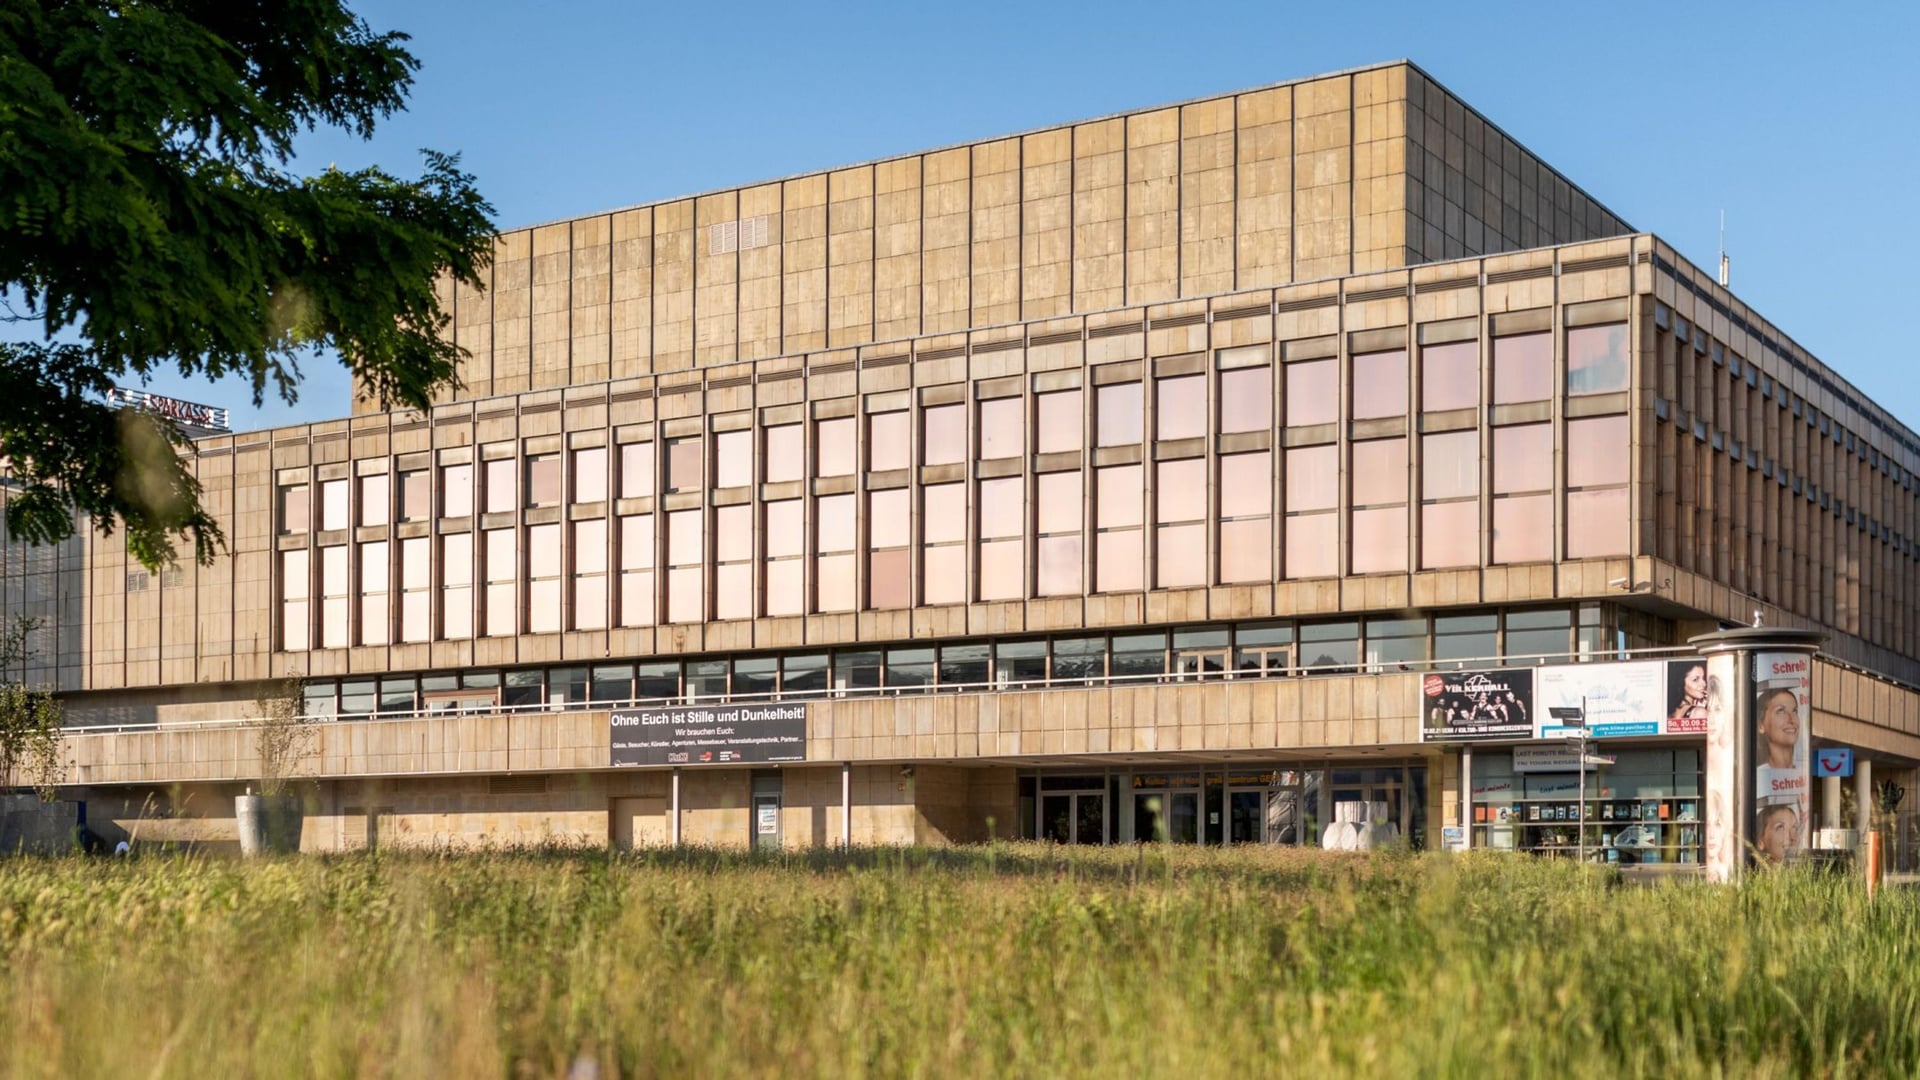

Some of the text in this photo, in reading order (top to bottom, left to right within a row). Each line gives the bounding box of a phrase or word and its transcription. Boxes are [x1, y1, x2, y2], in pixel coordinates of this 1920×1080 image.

[611, 707, 805, 727] Ohne Euch ist Stille und Dunkelheit!
[675, 727, 735, 736] Wir brauchen Euch:
